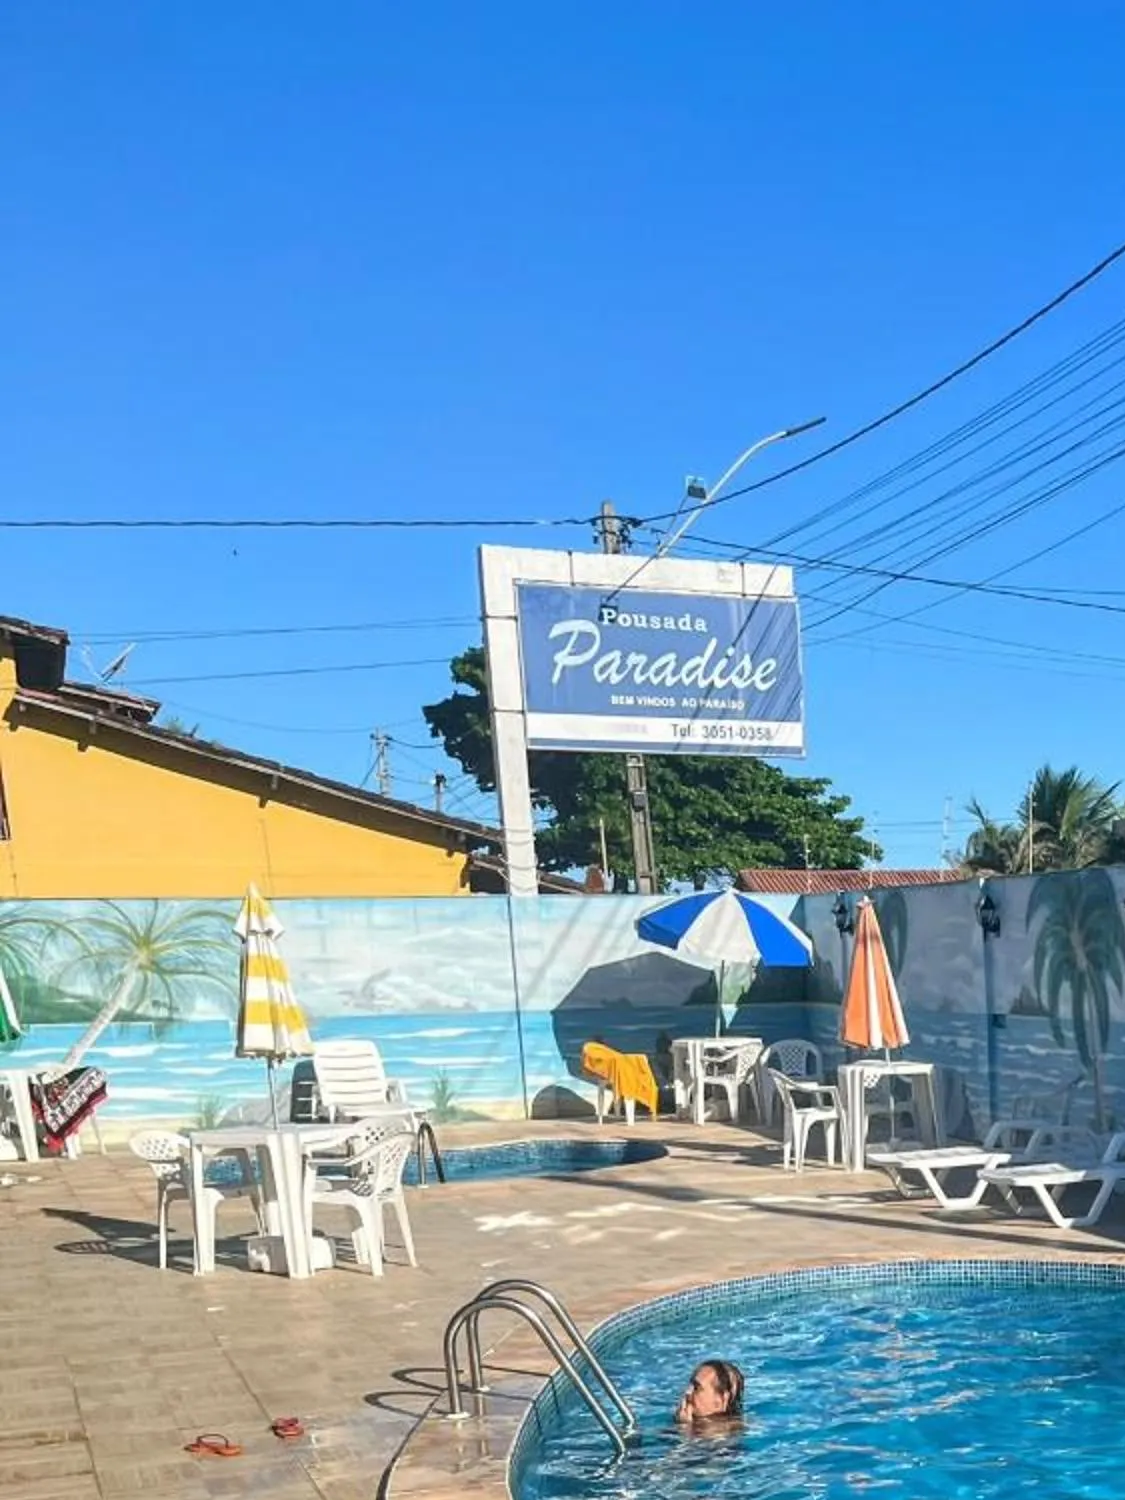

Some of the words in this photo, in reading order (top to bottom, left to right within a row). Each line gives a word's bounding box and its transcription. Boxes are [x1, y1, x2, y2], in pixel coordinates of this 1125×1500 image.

[601, 607, 707, 633] Pousada
[548, 619, 777, 691] Paradise
[611, 694, 634, 705] BEM
[635, 695, 676, 707] VINDOS
[681, 697, 697, 708] AO
